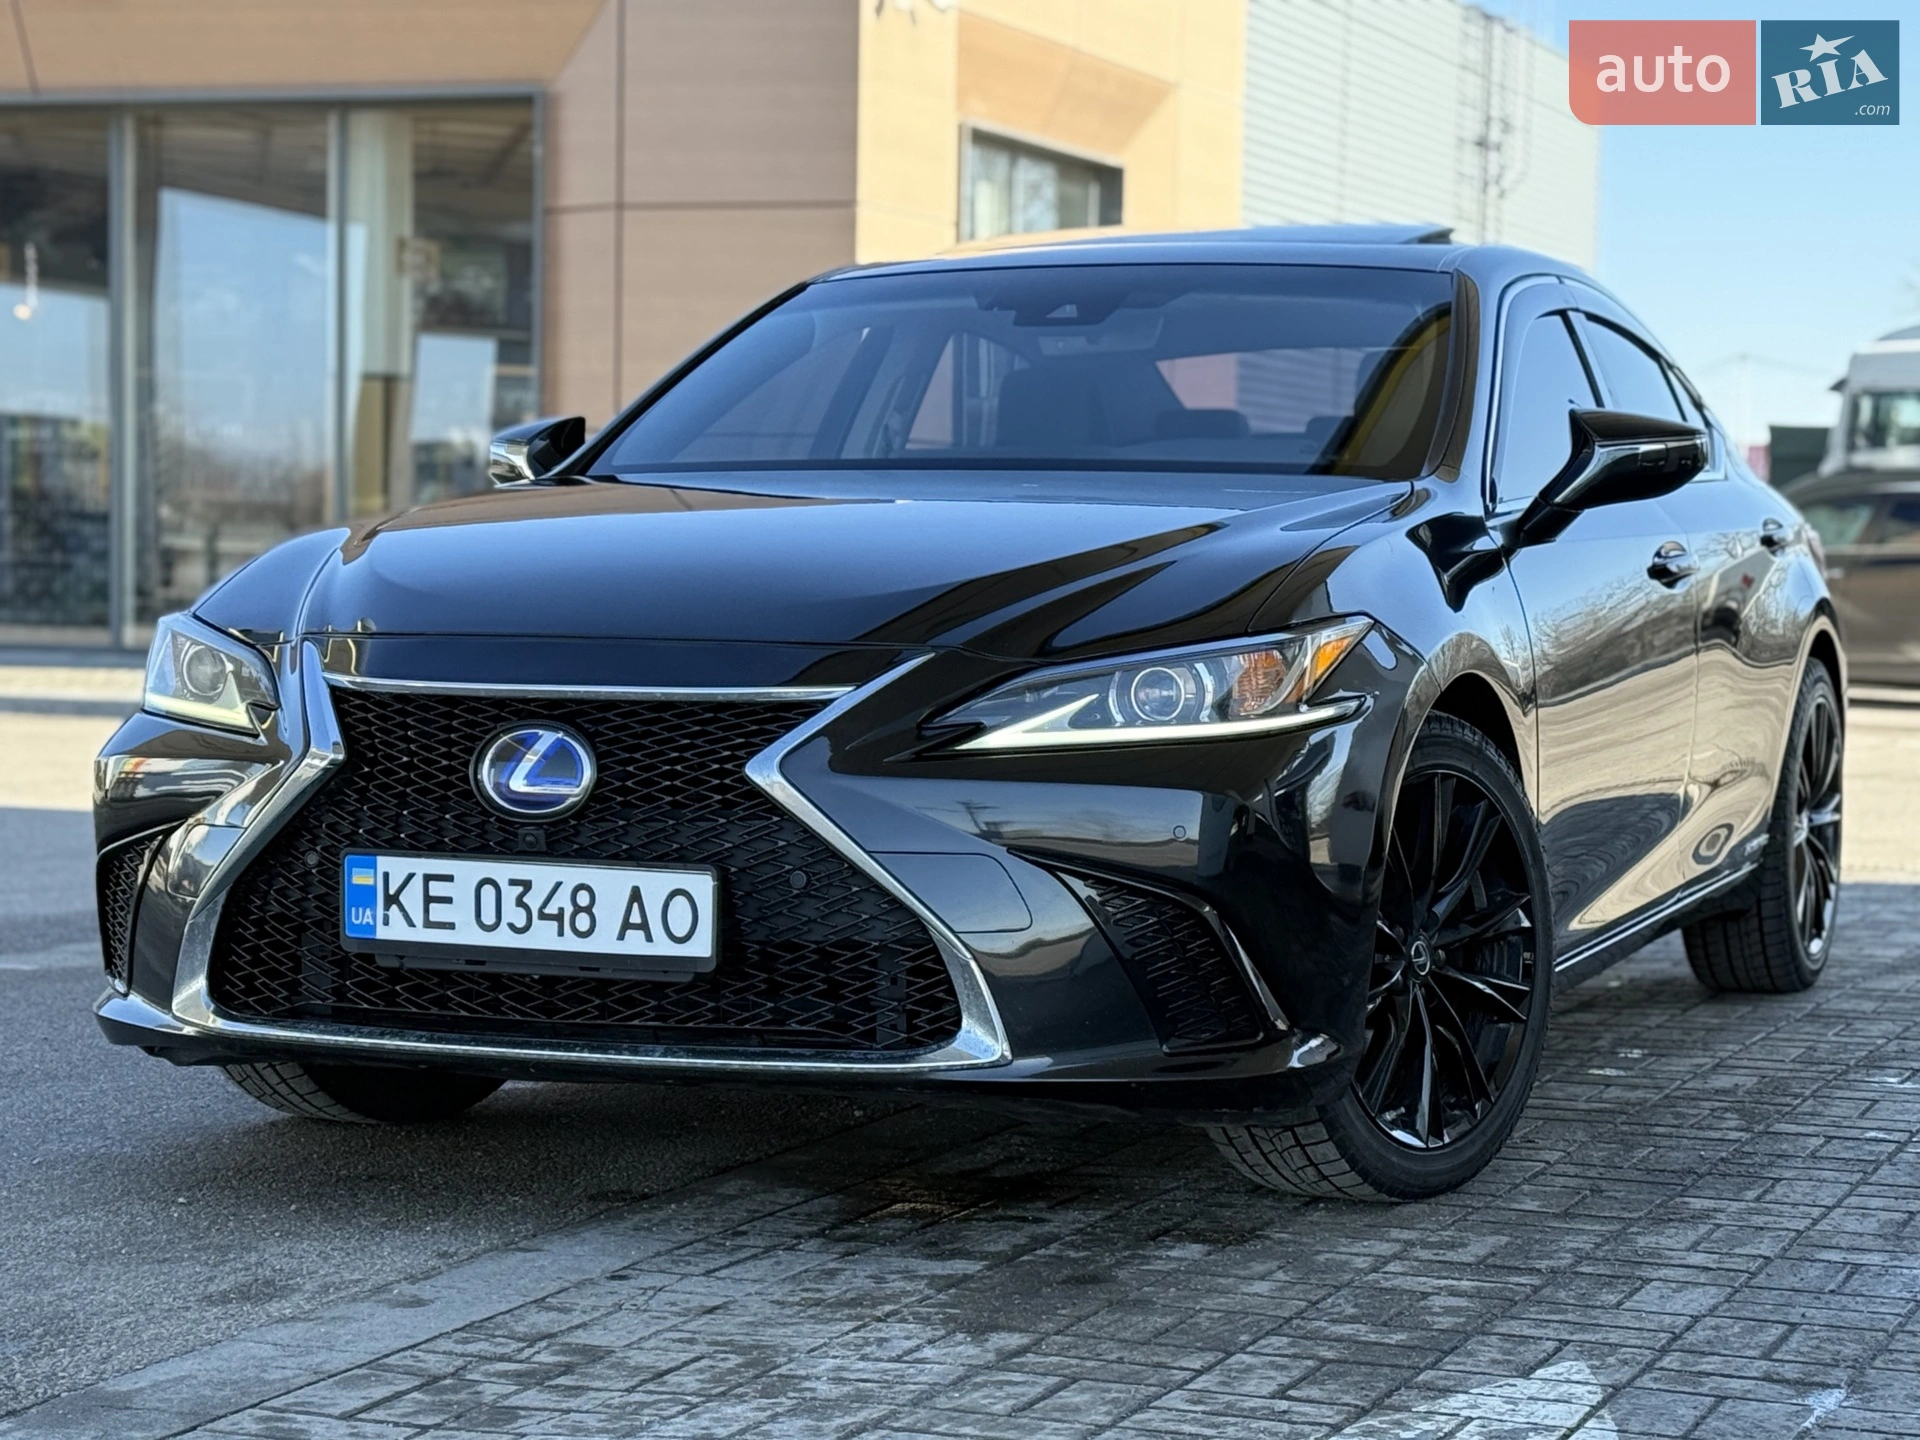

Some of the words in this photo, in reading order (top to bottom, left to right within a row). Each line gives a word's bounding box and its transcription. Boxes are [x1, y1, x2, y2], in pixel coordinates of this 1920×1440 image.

[351, 907, 374, 926] UA
[382, 871, 456, 930] KE
[474, 876, 597, 938] 0348
[616, 885, 699, 944] AO
